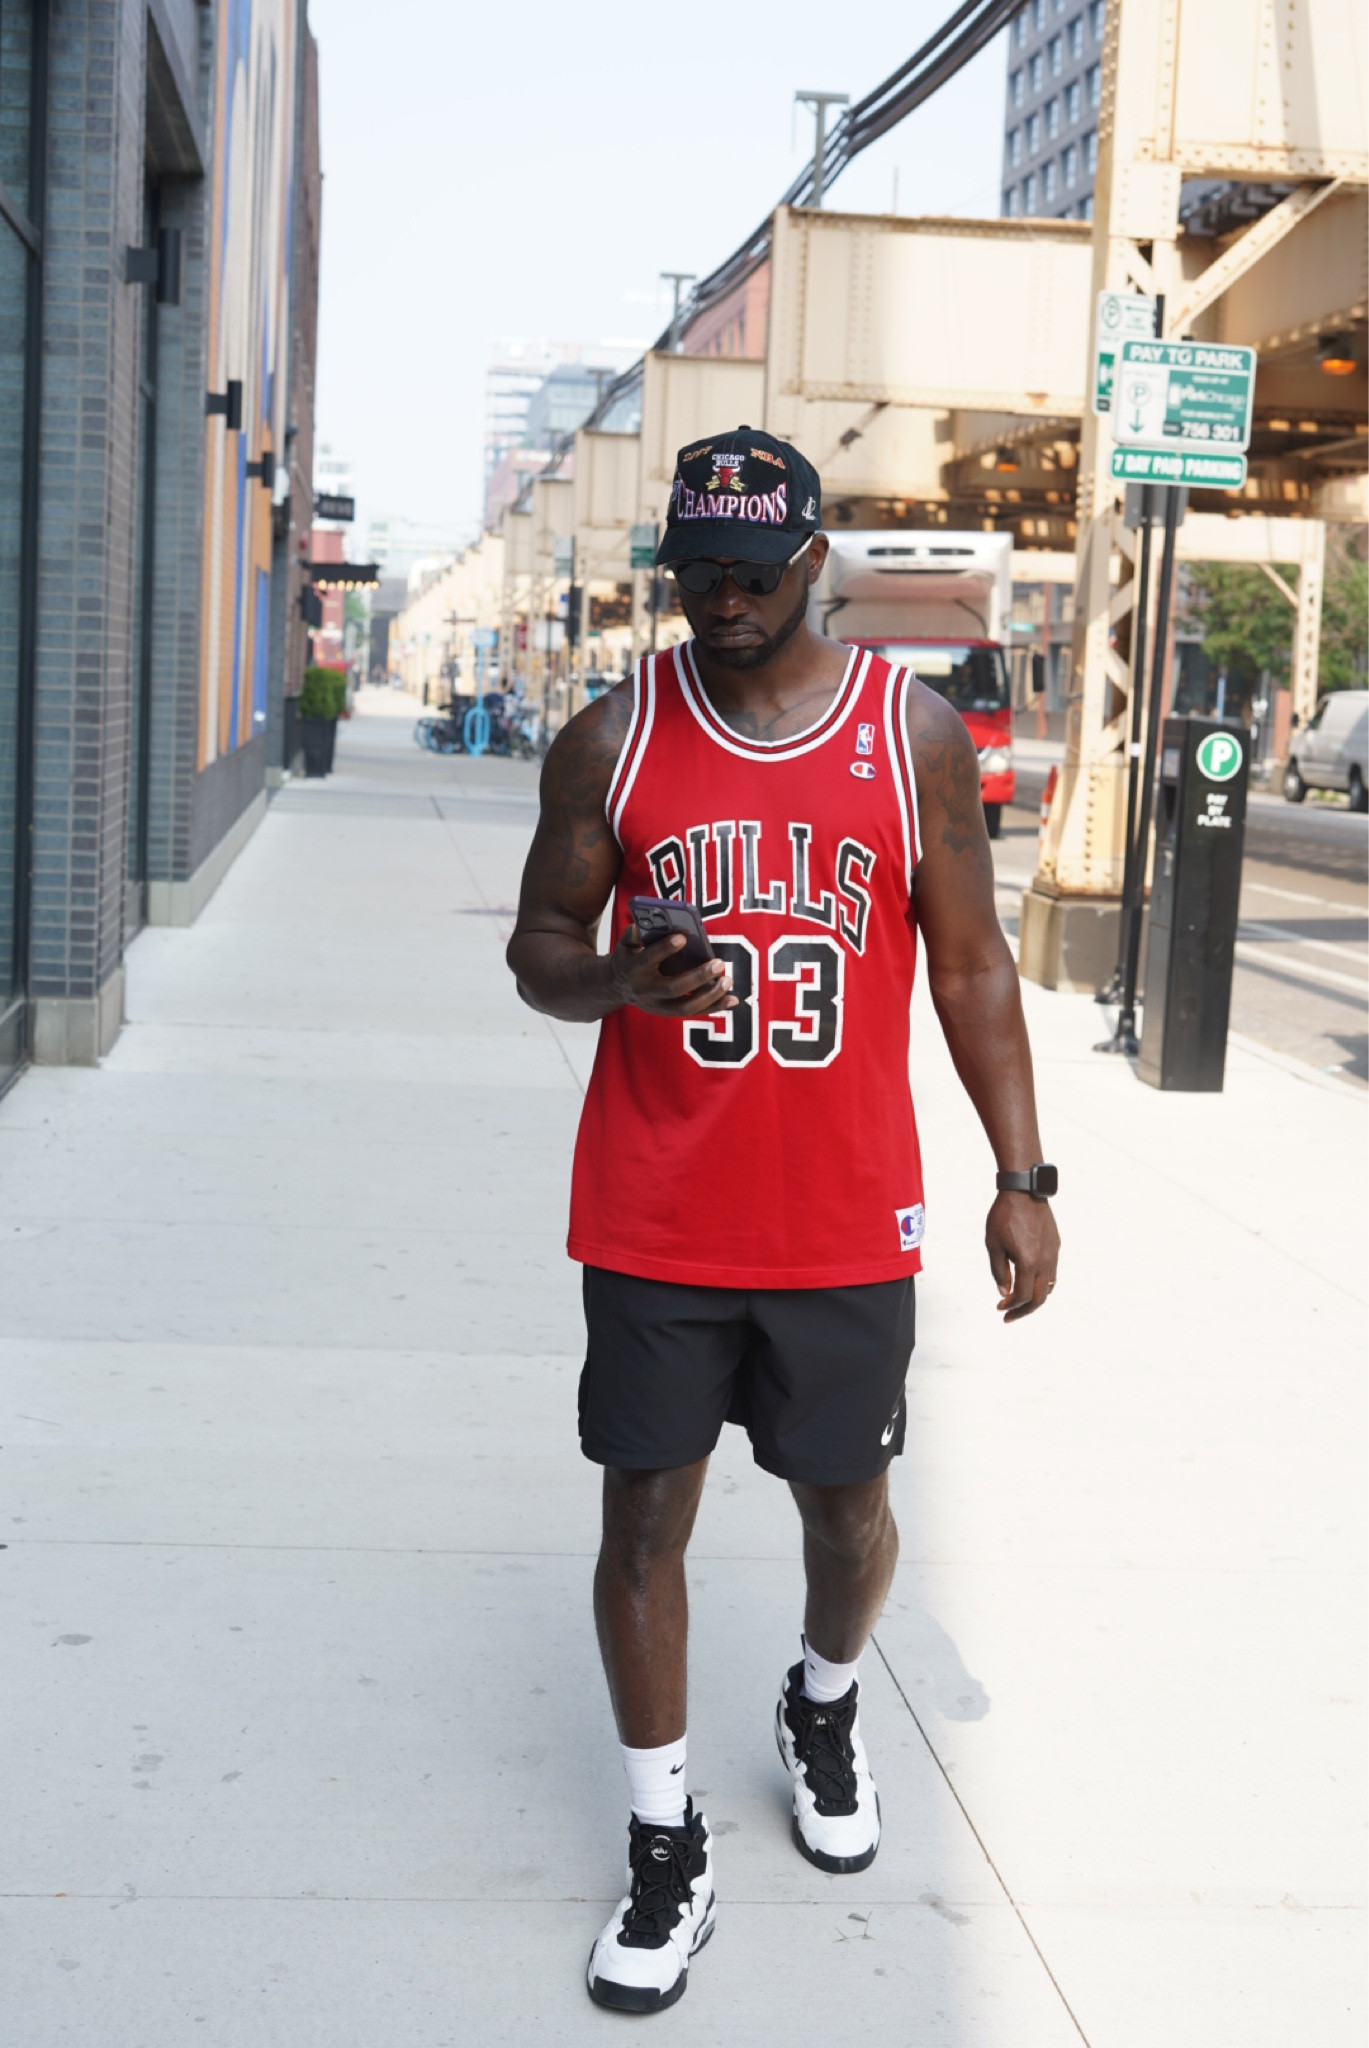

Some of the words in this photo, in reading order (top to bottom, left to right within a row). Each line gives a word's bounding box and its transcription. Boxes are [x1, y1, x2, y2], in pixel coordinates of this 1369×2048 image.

[1129, 344, 1164, 363] PAY
[1167, 348, 1190, 365] TO
[1195, 350, 1244, 369] PARK
[711, 453, 745, 461] CHICAGO
[750, 447, 786, 470] NBA
[1114, 454, 1123, 471] 7
[1125, 455, 1151, 473] DAY
[1153, 456, 1183, 475] PAID
[1185, 459, 1241, 479] PARKING
[673, 476, 787, 525] CHAMPIONS
[1209, 739, 1233, 773] P
[1206, 793, 1228, 806] PAY
[1208, 805, 1224, 816] BY
[1197, 814, 1232, 828] PLATE
[645, 819, 877, 957] BULLS
[683, 935, 845, 1069] 33
